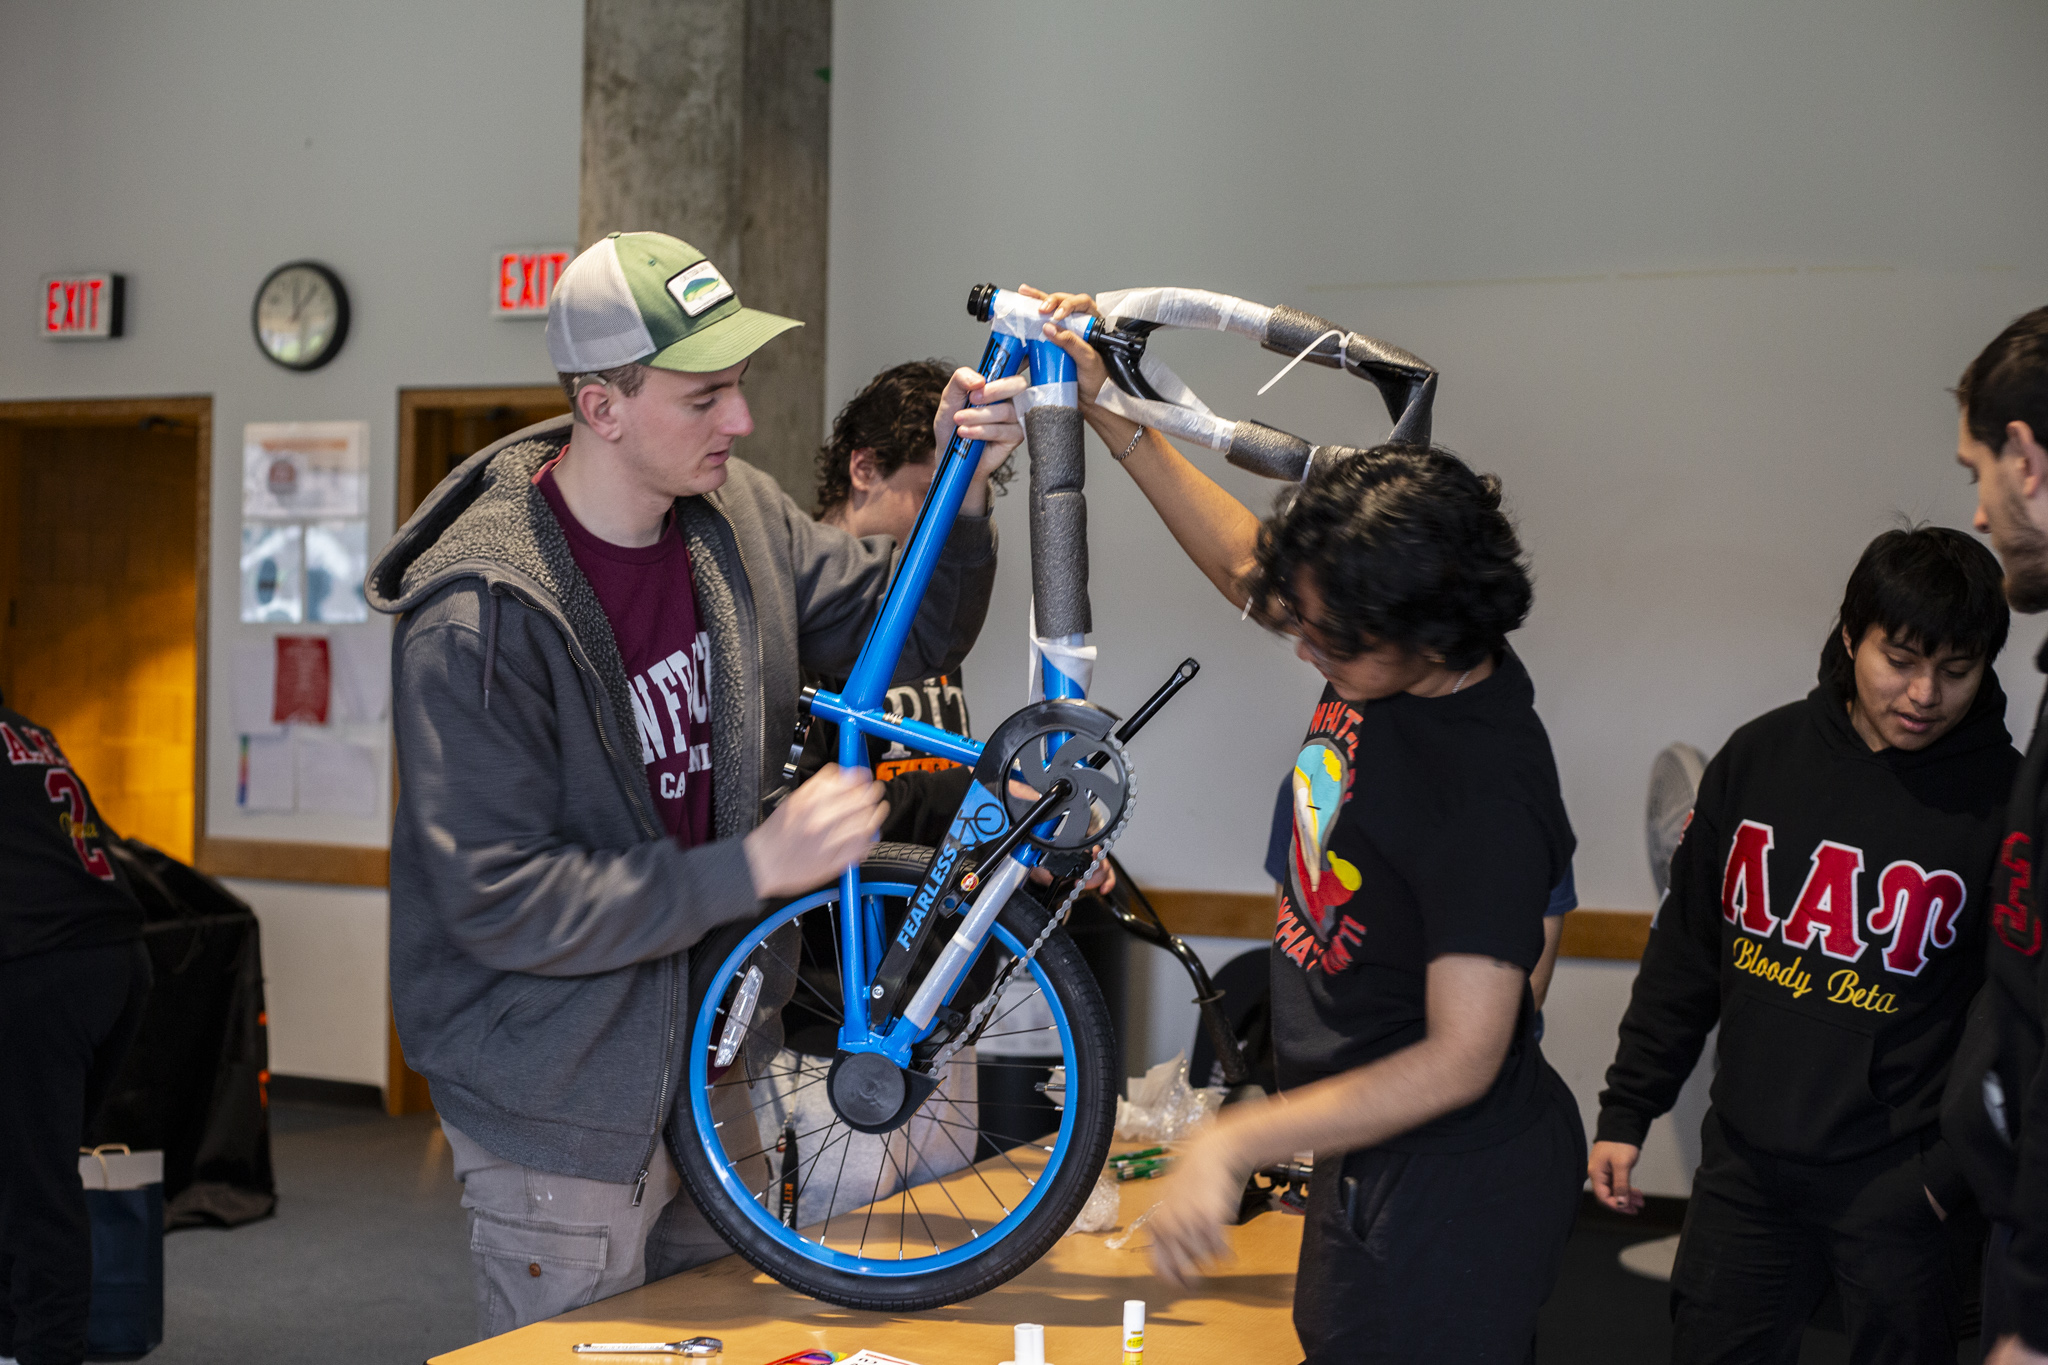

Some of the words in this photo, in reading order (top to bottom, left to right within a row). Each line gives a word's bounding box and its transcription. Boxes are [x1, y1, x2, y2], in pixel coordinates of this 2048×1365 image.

[47, 279, 104, 332] EXIT
[500, 252, 569, 310] EXIT
[45, 768, 116, 881] 2
[896, 842, 958, 951] FEARLESS
[1733, 936, 1812, 999] Bloody
[1827, 968, 1900, 1014] Beta
